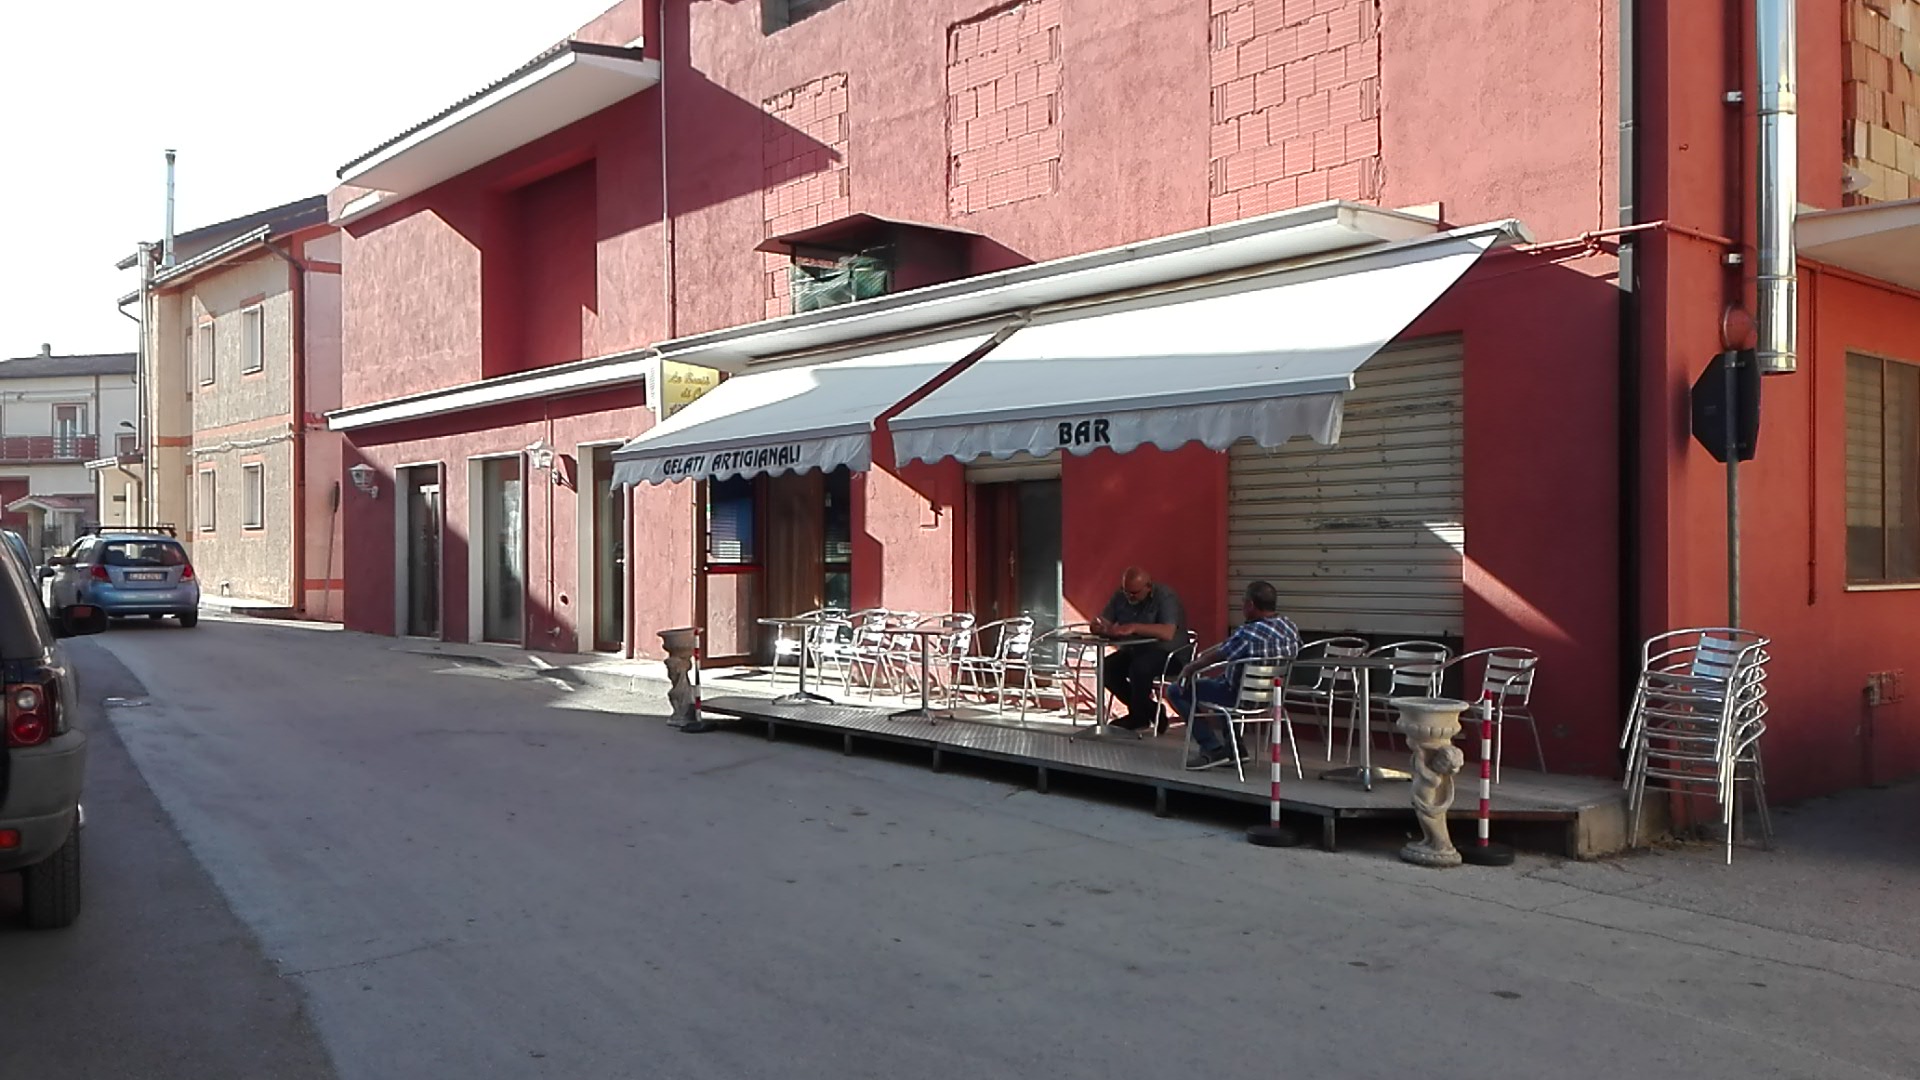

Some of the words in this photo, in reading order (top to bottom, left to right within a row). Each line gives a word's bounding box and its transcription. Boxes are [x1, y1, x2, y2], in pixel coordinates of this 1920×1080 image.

[1058, 418, 1111, 446] BAR
[663, 455, 705, 476] GELATI
[711, 444, 801, 472] ARTIGIANALI
